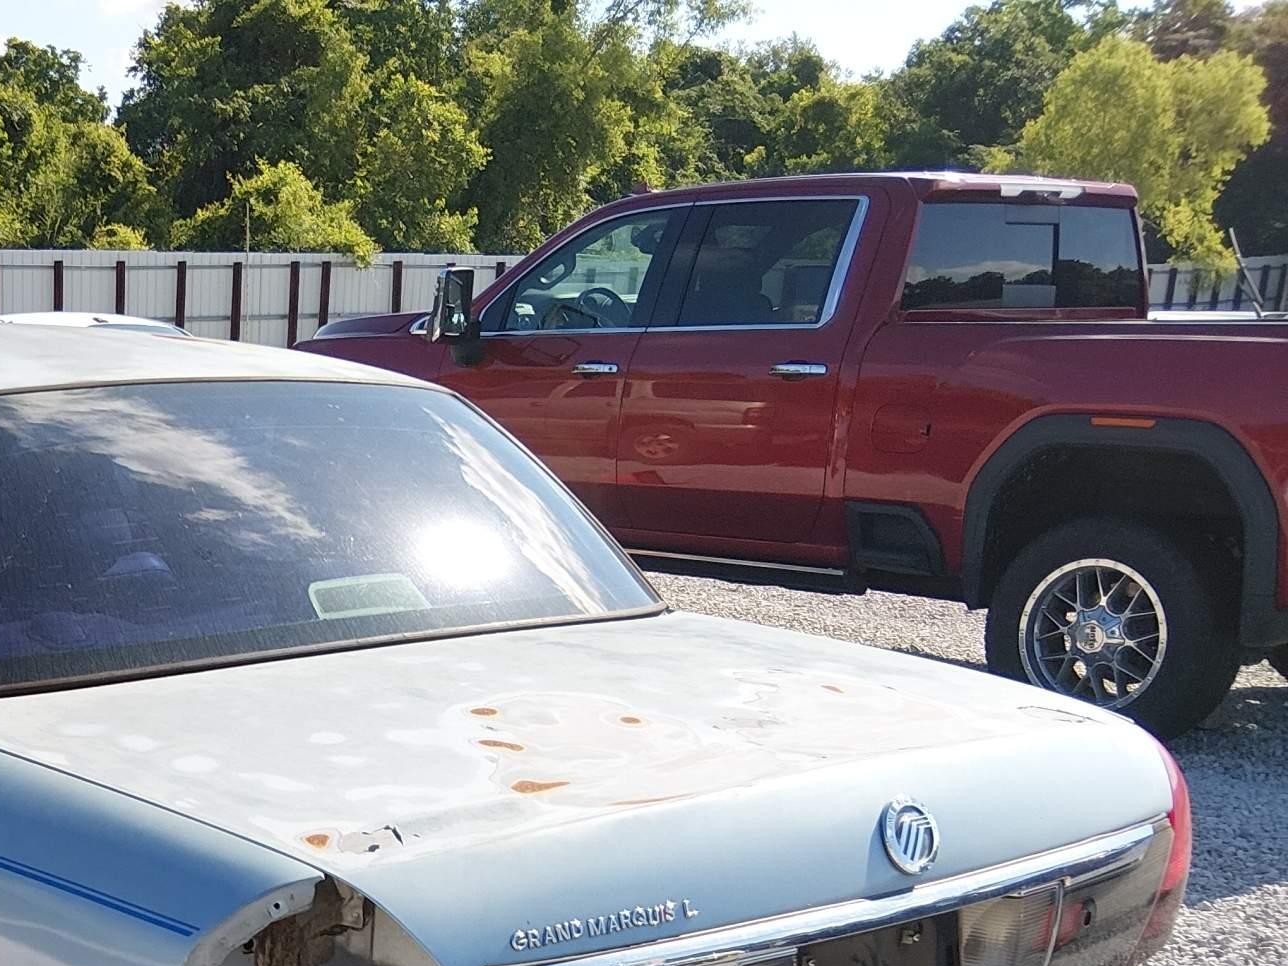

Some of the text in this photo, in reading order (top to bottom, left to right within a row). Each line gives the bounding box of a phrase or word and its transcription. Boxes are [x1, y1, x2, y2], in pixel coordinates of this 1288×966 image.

[510, 898, 699, 951] GRAND MARQUIS L
